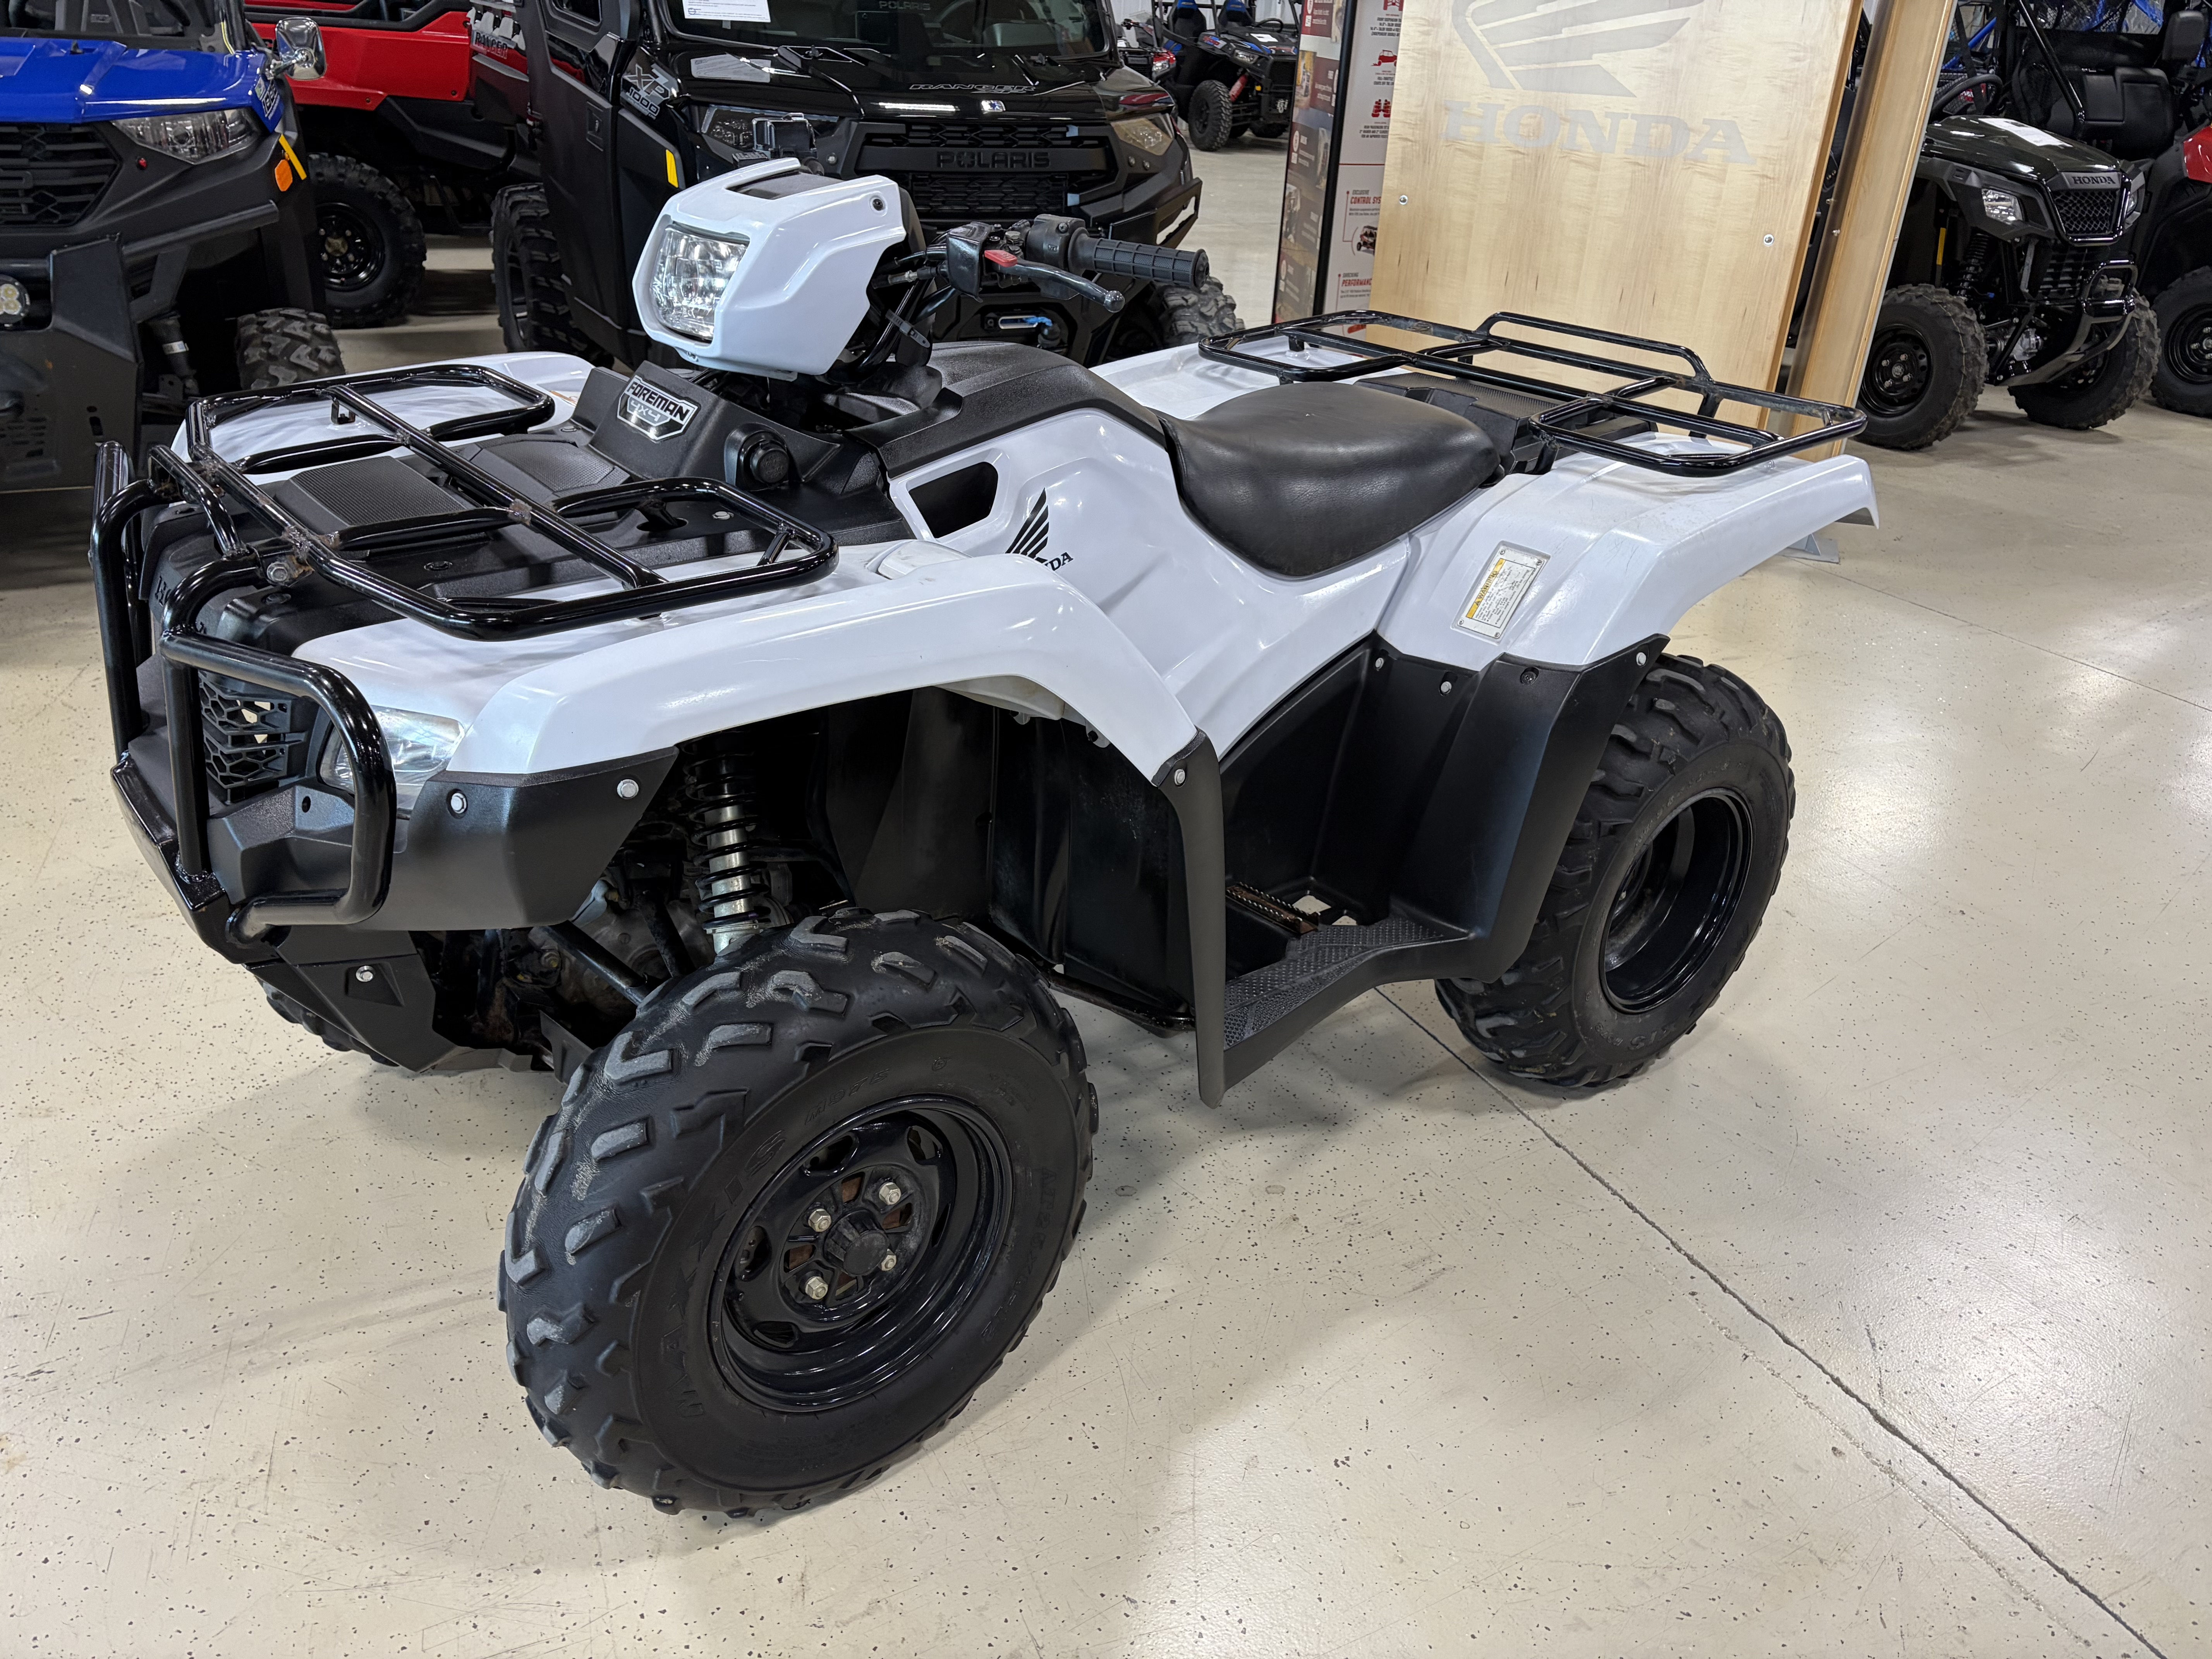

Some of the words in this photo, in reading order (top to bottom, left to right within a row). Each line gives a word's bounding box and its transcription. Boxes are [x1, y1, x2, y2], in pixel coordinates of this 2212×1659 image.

[879, 1, 931, 10] POLARIS
[622, 63, 671, 100] XP
[625, 86, 660, 117] 1000
[1439, 99, 1757, 165] HONDA
[937, 151, 1050, 168] POLARIS
[2071, 176, 2116, 184] HONDA
[627, 381, 690, 421] FOREMAN
[1477, 570, 1498, 599] WARNING
